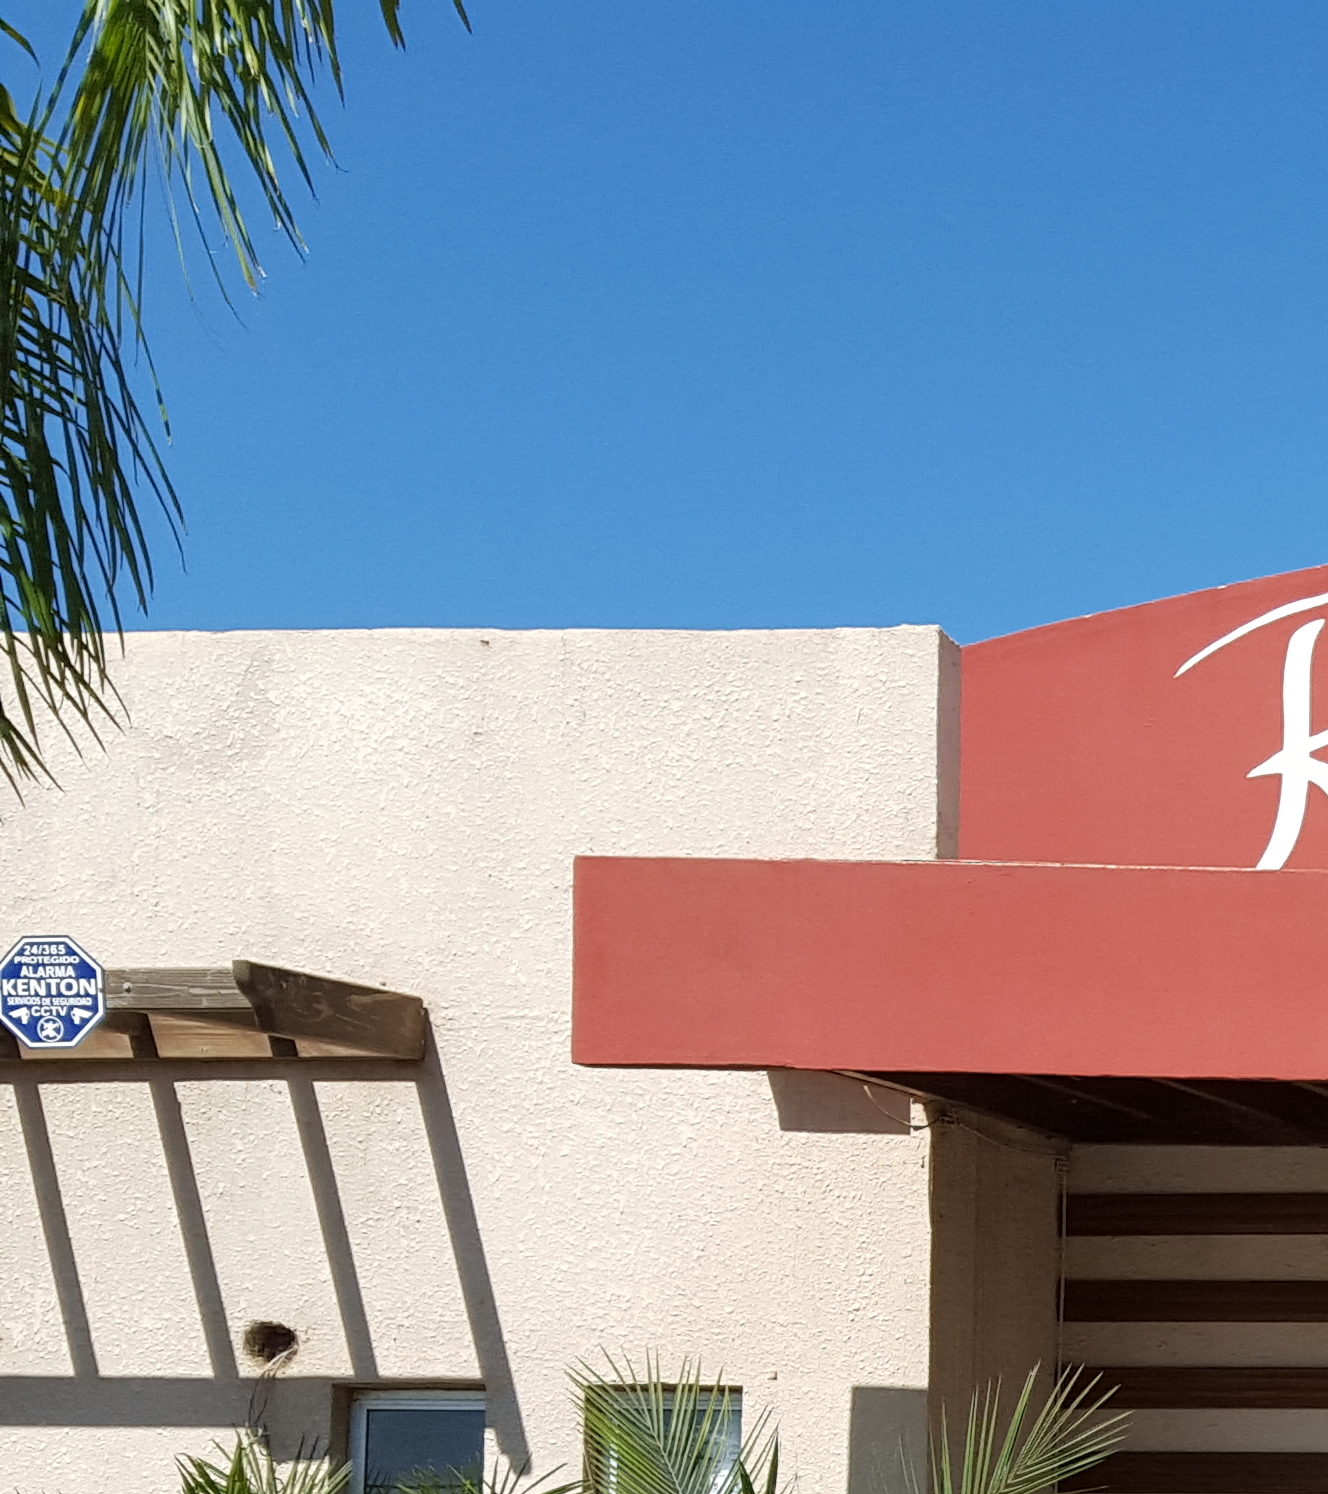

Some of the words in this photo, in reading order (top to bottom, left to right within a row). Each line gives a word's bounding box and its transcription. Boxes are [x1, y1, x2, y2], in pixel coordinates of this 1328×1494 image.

[23, 944, 66, 955] 24/365
[14, 956, 80, 964] PROTEGIDO
[20, 965, 76, 978] ALARMA
[2, 978, 97, 996] KENTON
[31, 1006, 67, 1017] CCTV
